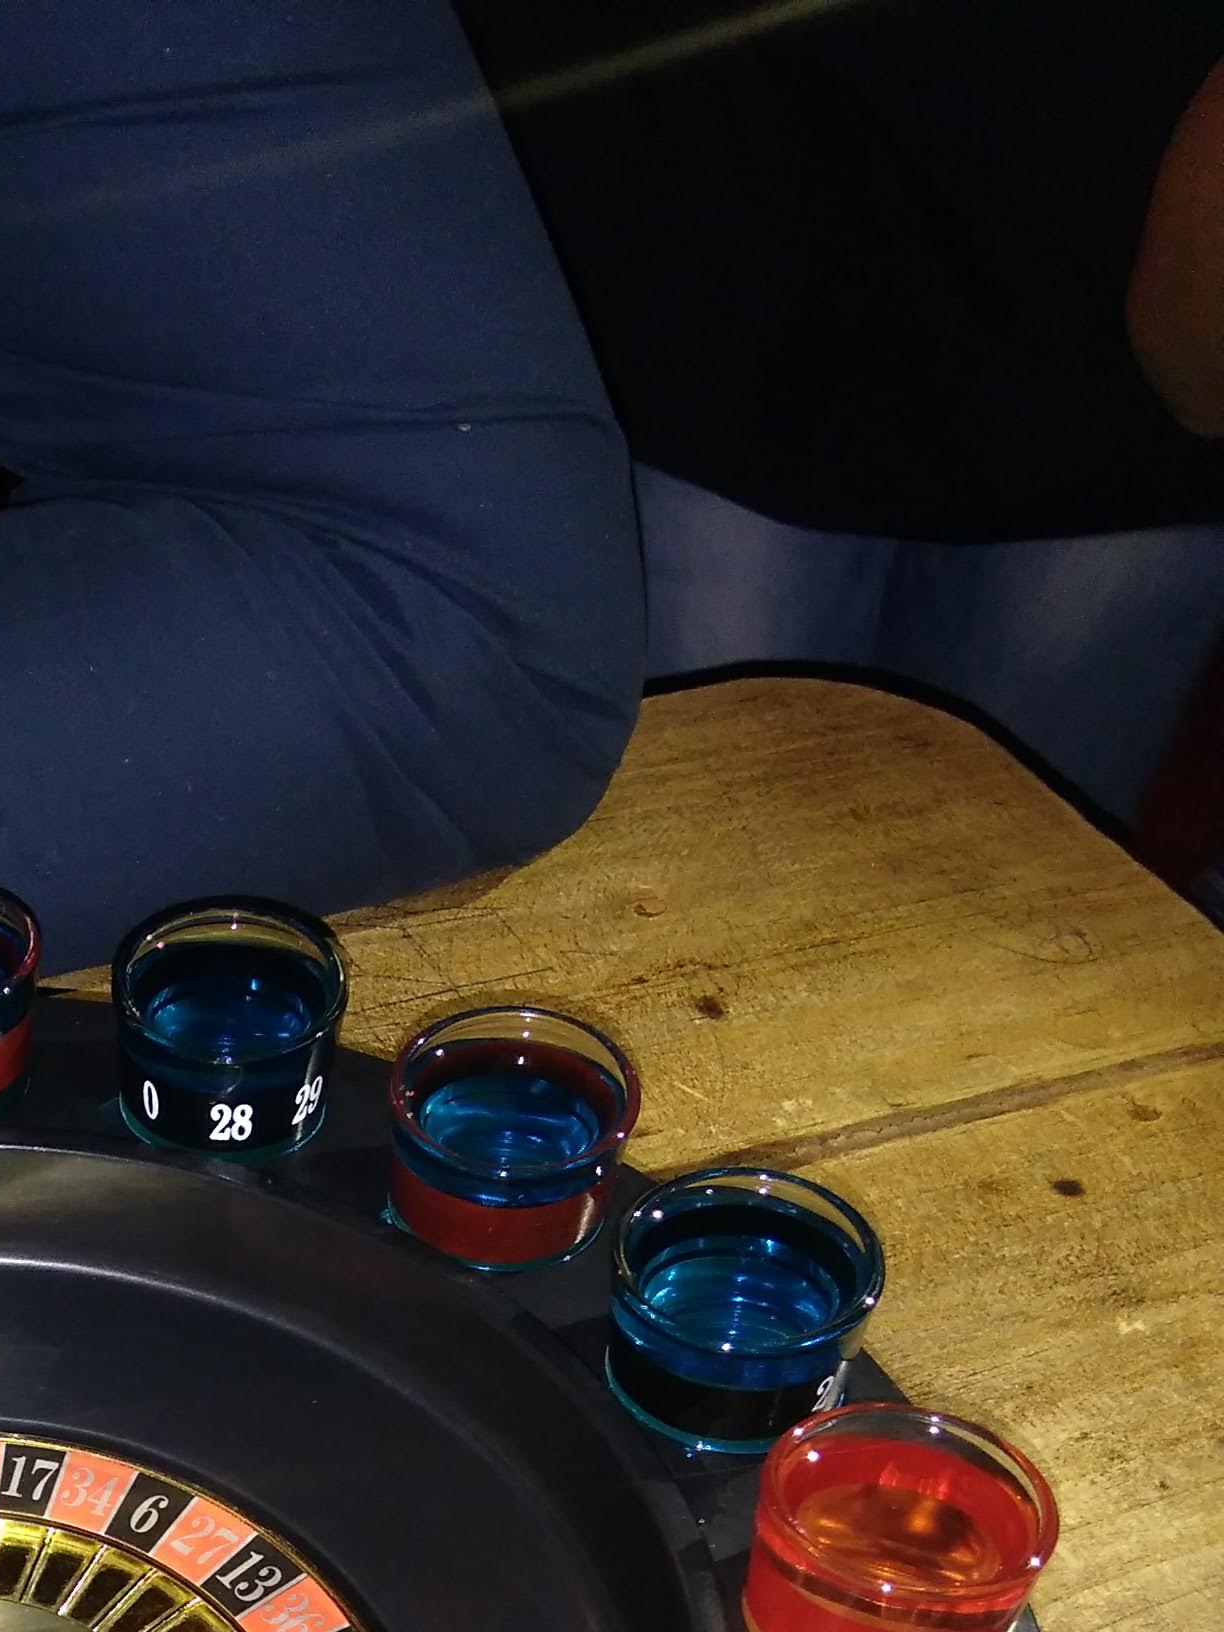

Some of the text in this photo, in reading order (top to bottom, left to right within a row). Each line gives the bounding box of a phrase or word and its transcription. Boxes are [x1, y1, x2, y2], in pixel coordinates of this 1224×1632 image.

[143, 1075, 323, 1141] 0 28 29
[1, 1455, 60, 1501] 17
[60, 1467, 119, 1517] 34
[129, 1495, 169, 1533] 6
[169, 1514, 240, 1565] 27
[216, 1550, 283, 1602] 13
